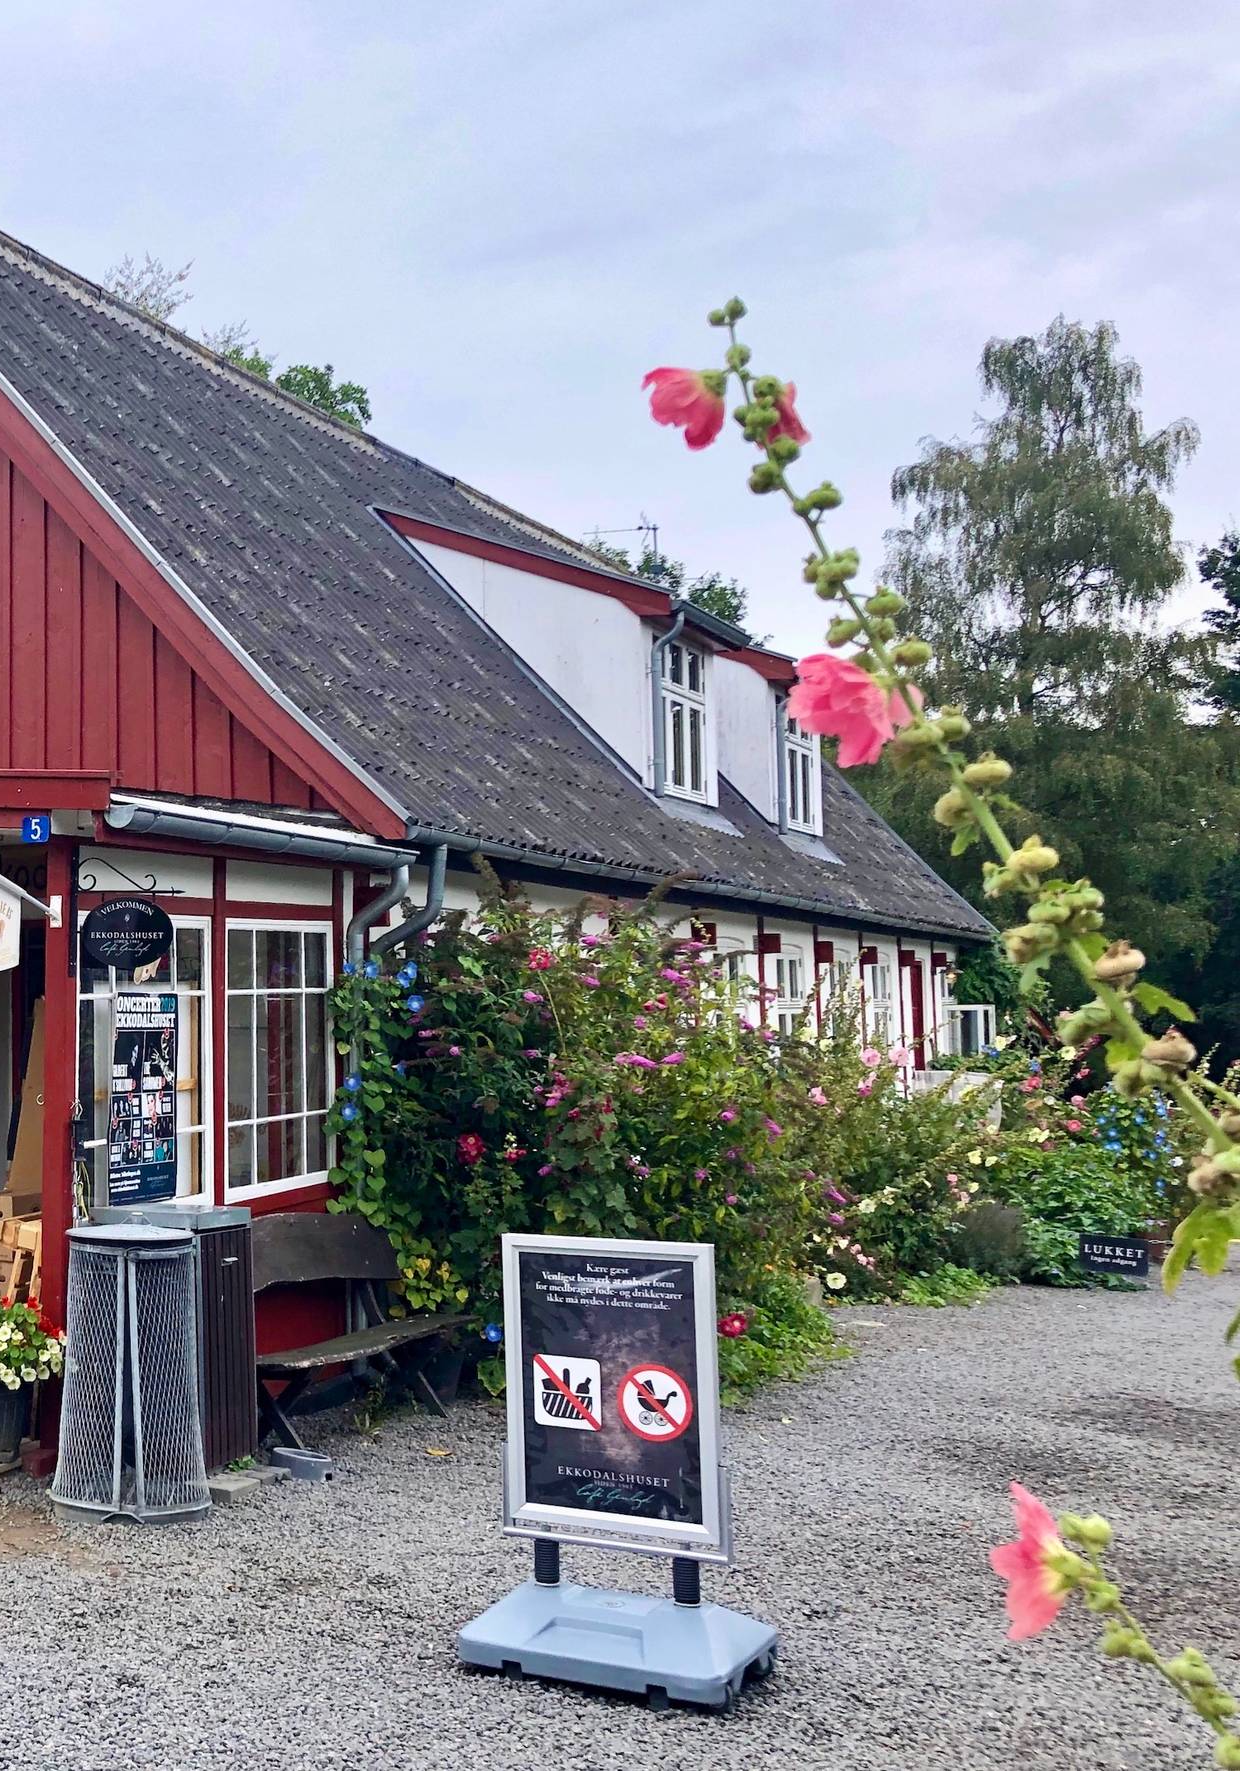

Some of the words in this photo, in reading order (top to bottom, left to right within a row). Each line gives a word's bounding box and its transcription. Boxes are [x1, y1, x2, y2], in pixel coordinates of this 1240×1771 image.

[30, 818, 41, 840] 5
[100, 900, 154, 916] VELKOMMEN
[90, 931, 164, 940] EKKODALSHUSET
[116, 1013, 176, 1028] EKKODALSHUSET
[1084, 1243, 1145, 1259] LUKKET
[586, 1263, 609, 1273] Kære
[609, 1267, 630, 1276] gæst
[542, 1271, 576, 1284] Venligst
[577, 1273, 611, 1284] bemærk
[653, 1278, 675, 1288] form
[535, 1281, 547, 1290] for
[549, 1282, 594, 1296] medbragte
[619, 1290, 631, 1299] og
[631, 1288, 683, 1301] drikkevarer
[546, 1293, 564, 1303] ikke
[565, 1295, 579, 1304] må
[580, 1296, 605, 1307] nydes
[611, 1298, 633, 1308] dette
[557, 1465, 670, 1488] EKKODALSHUSET
